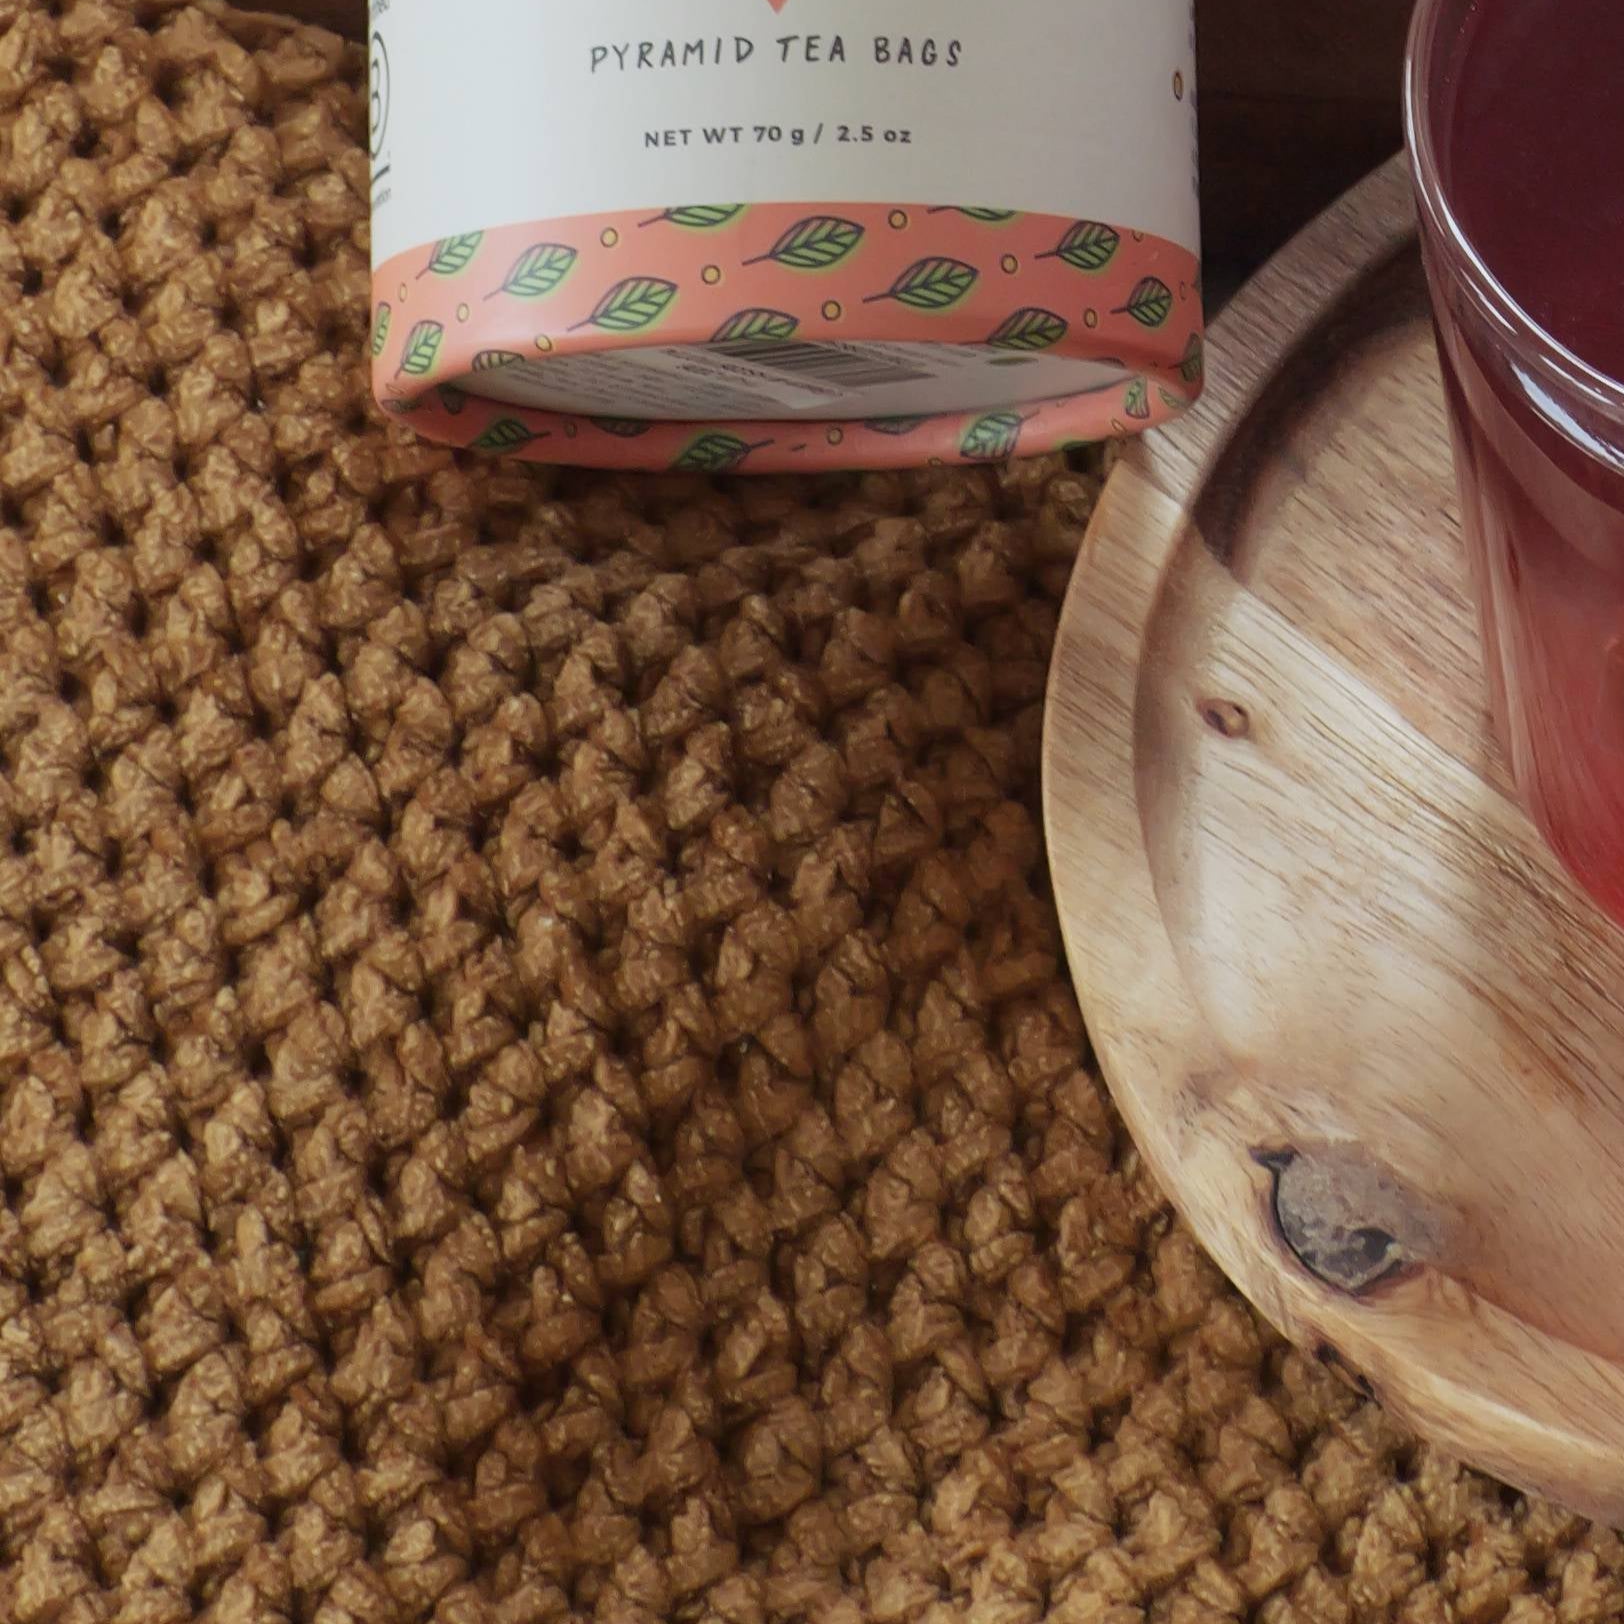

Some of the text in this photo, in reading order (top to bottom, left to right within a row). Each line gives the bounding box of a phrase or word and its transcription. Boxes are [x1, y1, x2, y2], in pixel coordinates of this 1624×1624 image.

[590, 34, 963, 74] PYRAMID TEA BAGS
[644, 127, 693, 149] NET
[701, 126, 744, 145] WT
[752, 125, 783, 143] 70
[836, 124, 875, 144] 2.5
[883, 129, 912, 144] oz
